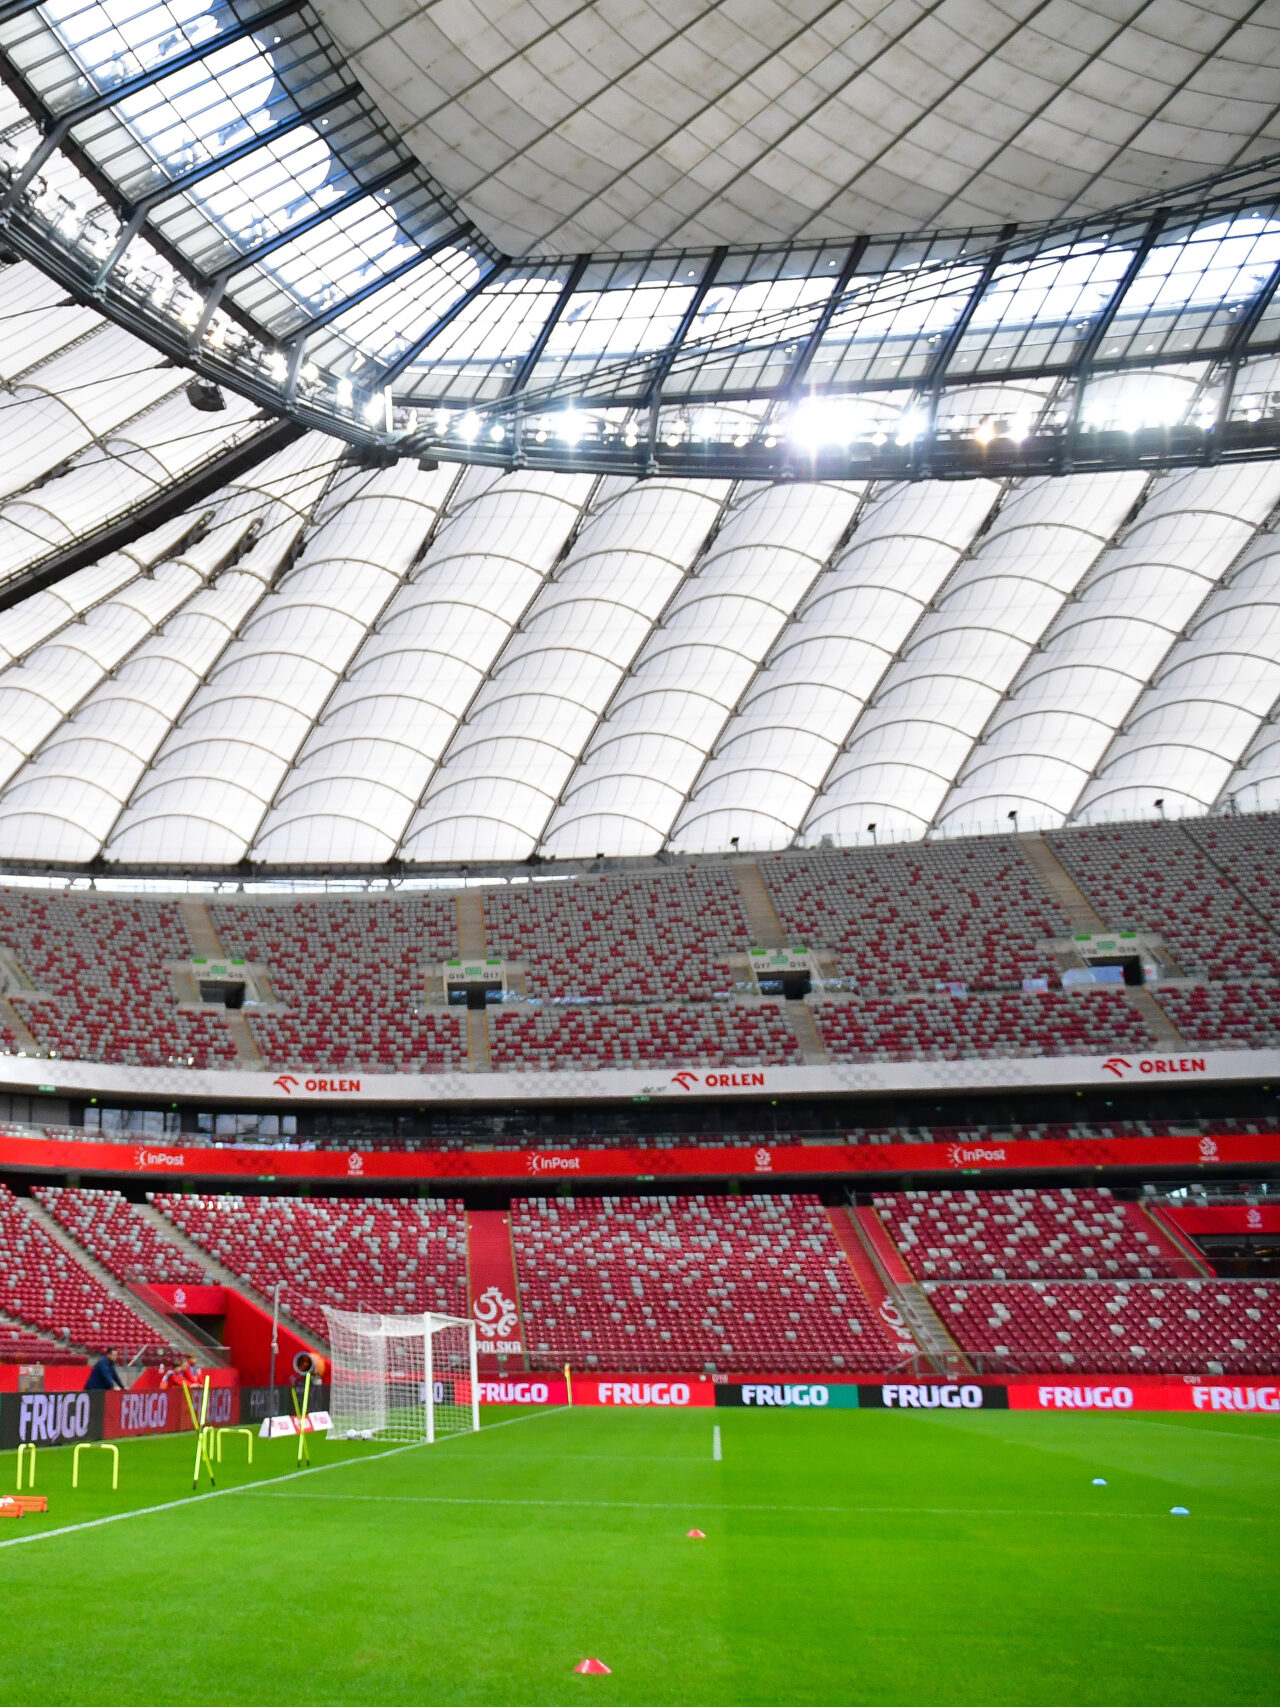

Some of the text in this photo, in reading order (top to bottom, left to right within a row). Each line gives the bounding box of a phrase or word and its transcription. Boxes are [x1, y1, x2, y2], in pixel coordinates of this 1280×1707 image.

[1140, 1058, 1206, 1073] ORLEN
[304, 1079, 361, 1092] ORLEN
[704, 1072, 765, 1087] ORLEN
[147, 1152, 184, 1166] InPost
[541, 1156, 580, 1169] InPost
[962, 1148, 1006, 1161] InPost
[476, 1340, 522, 1354] POLSKA
[477, 1382, 549, 1403] FRUGO
[598, 1382, 690, 1405] FRUGO
[741, 1384, 830, 1406] FRUGO
[882, 1384, 983, 1408] FRUGO
[1038, 1386, 1134, 1408] FRUGO
[20, 1392, 90, 1443] FRUGO
[121, 1392, 168, 1429] FRUGO
